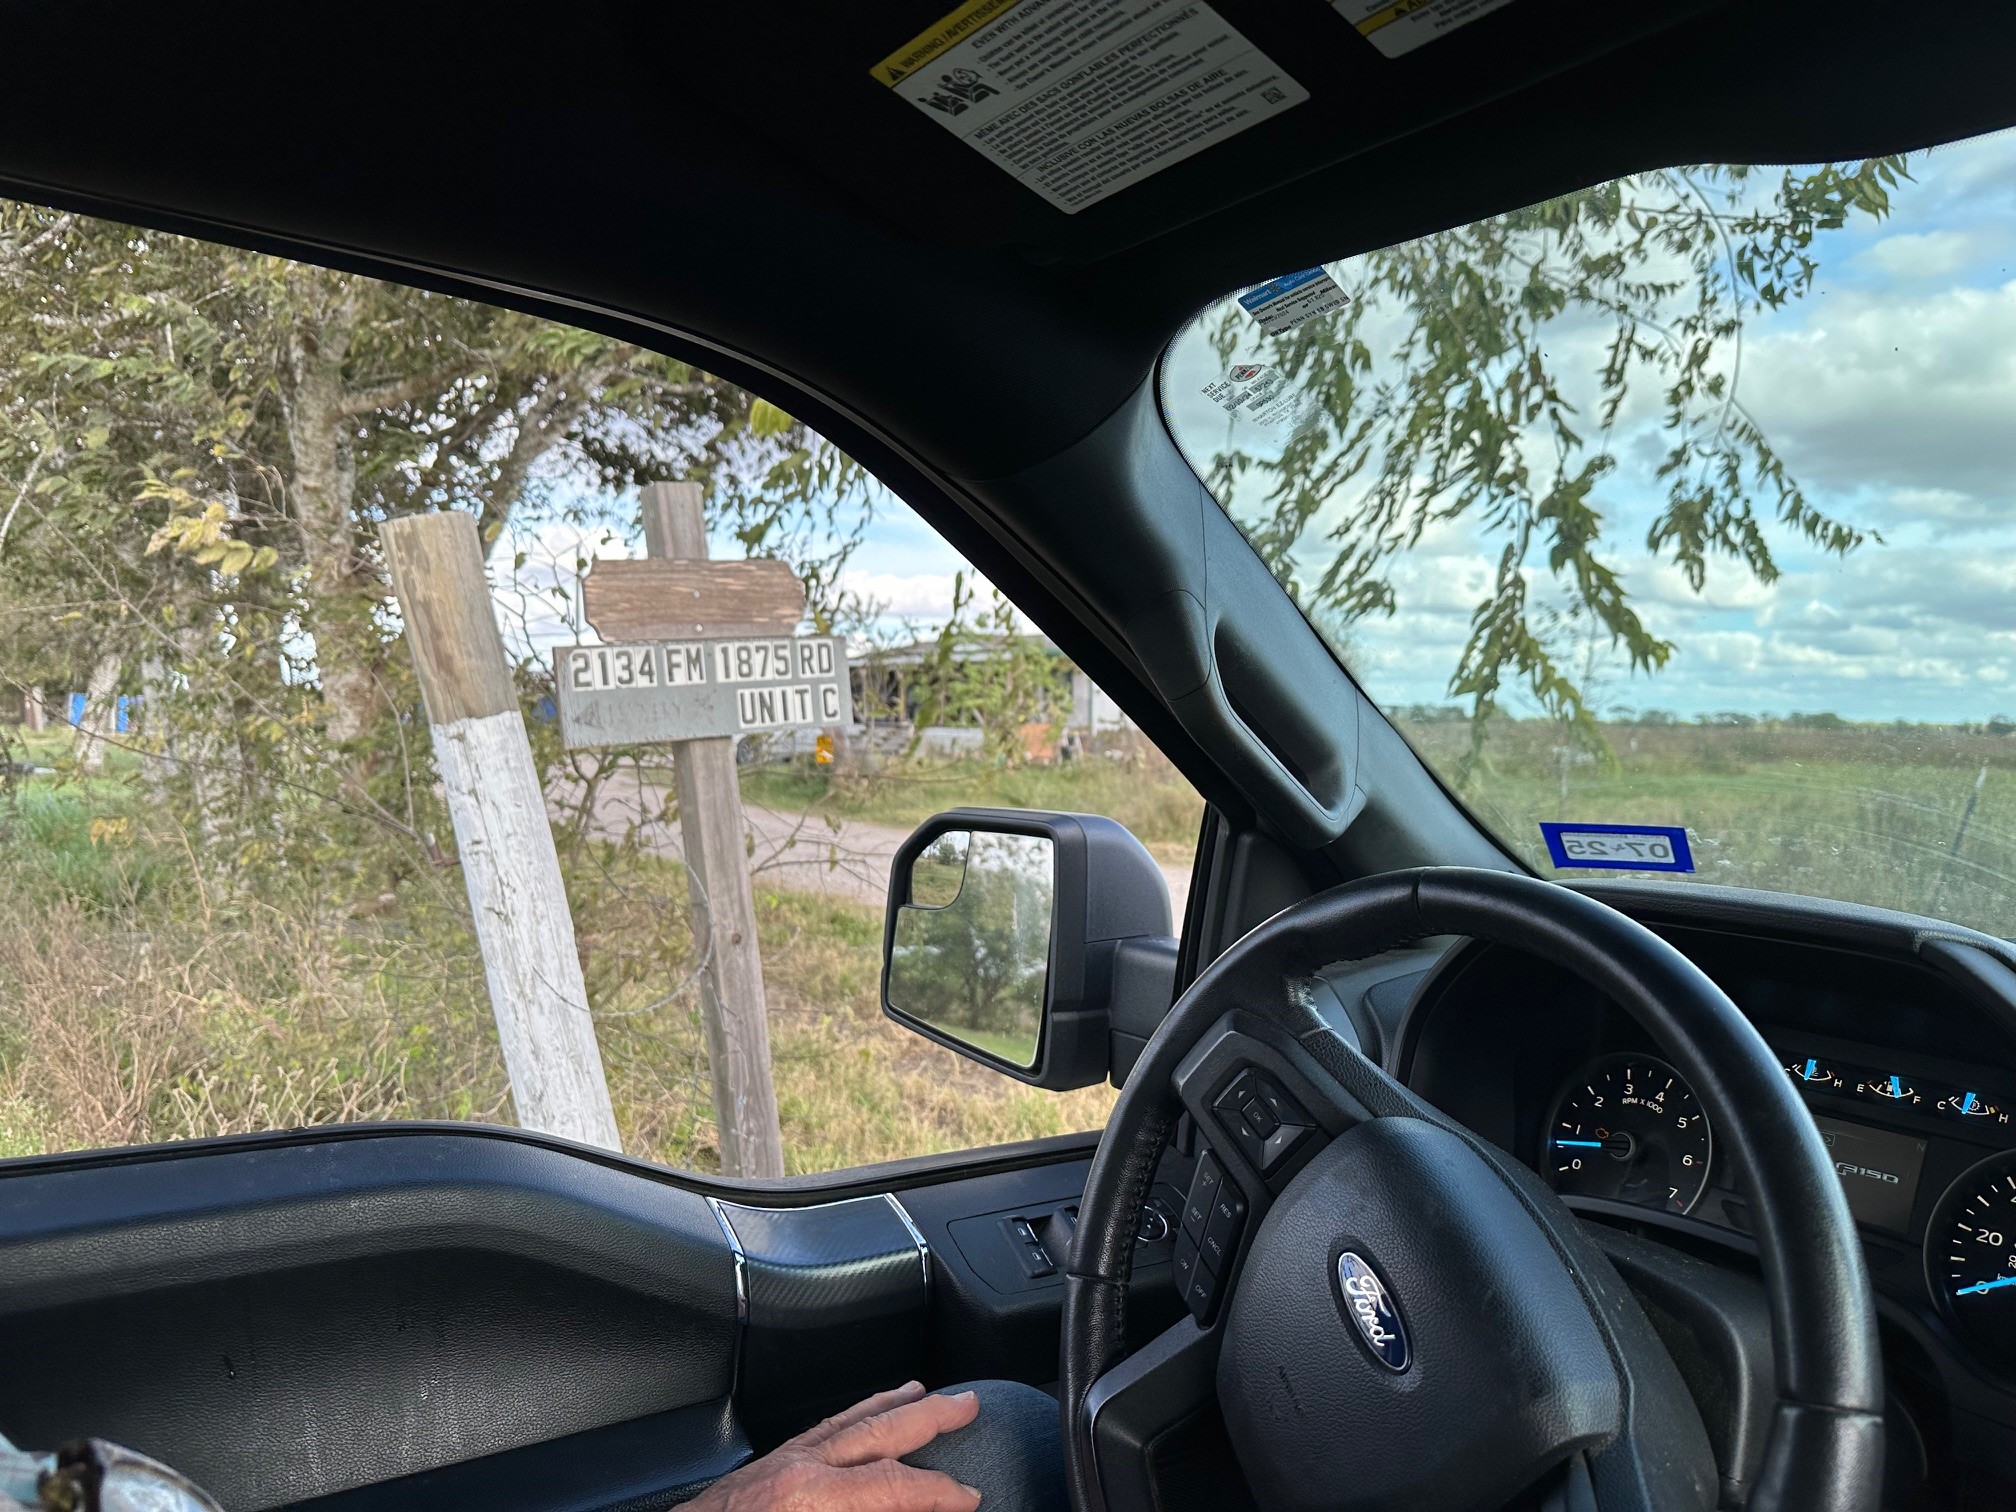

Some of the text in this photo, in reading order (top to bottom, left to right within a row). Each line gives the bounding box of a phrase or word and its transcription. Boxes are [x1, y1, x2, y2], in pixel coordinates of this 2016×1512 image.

[971, 31, 997, 49] EVEN
[994, 16, 1020, 34] WITH
[900, 38, 945, 68] WARNING
[998, 110, 1021, 126] AVEC
[1018, 100, 1038, 114] DES
[1036, 87, 1062, 104] SACS
[1036, 147, 1080, 172] INCLUSIVE
[1077, 137, 1098, 150] CON
[1095, 128, 1116, 140] LAS
[1113, 109, 1151, 130] NUEVAS
[1148, 89, 1188, 112] BOLSAS
[1187, 81, 1203, 92] DE
[1203, 69, 1228, 84] AIRE
[1243, 289, 1272, 305] Walmart
[1201, 382, 1216, 394] NEXT
[1207, 381, 1231, 398] SERVICE
[1212, 393, 1226, 403] DUE
[573, 643, 832, 688] 2134 FM 1875 RD
[740, 687, 839, 724] UNIT C
[1624, 1084, 1634, 1095] 3
[1834, 1079, 1843, 1088] H
[1594, 1096, 1604, 1107] 2
[1655, 1092, 1665, 1103] 4
[1857, 1083, 1921, 1105] E F
[1622, 1097, 1638, 1105] RPM
[1646, 1100, 1663, 1114] 1000
[1937, 1101, 2009, 1124] C H
[1253, 1112, 1262, 1123] OK
[1677, 1117, 1688, 1129] 5
[1572, 1158, 1581, 1170] 0
[1682, 1154, 1693, 1166] 6
[1203, 1171, 1214, 1185] SET
[1669, 1187, 1678, 1199] 7
[1191, 1206, 1202, 1221] SET
[1220, 1203, 1232, 1219] RES
[1976, 1228, 2003, 1246] 20
[1207, 1236, 1222, 1256] CNCL
[1195, 1284, 1207, 1299] OFF
[1345, 1274, 1396, 1347] Ford
